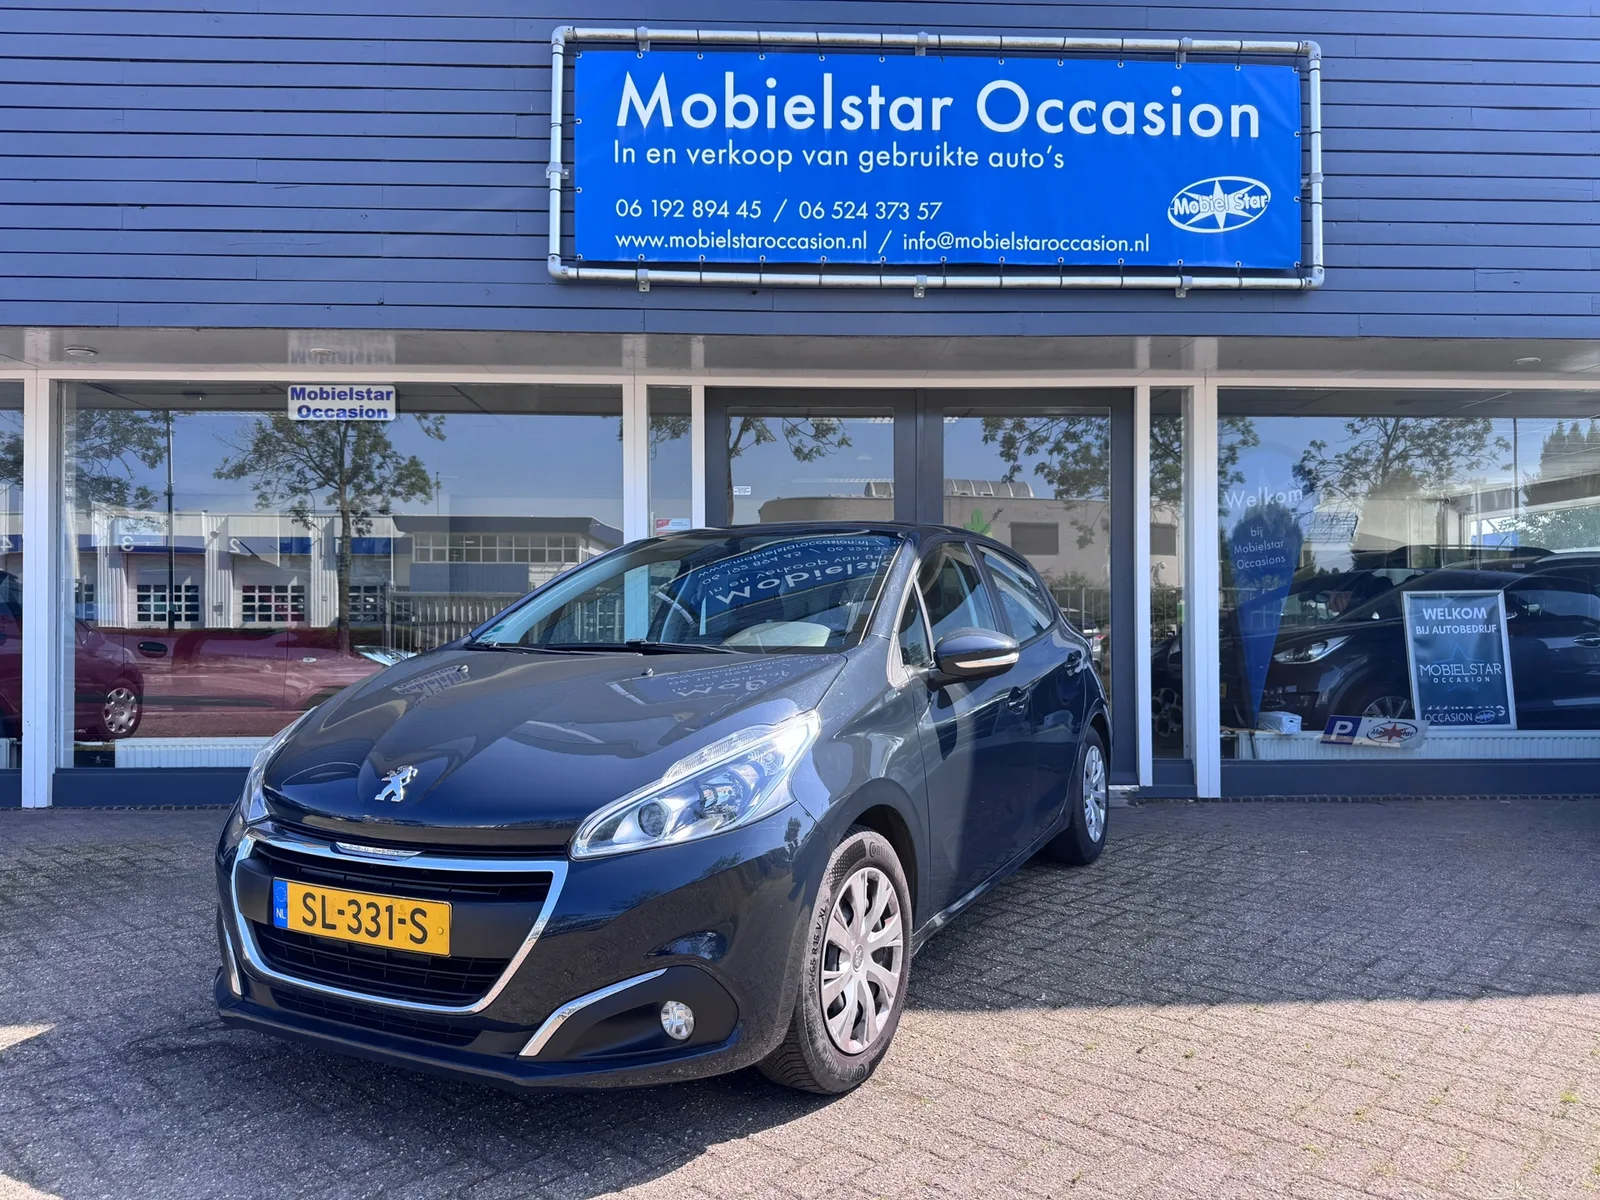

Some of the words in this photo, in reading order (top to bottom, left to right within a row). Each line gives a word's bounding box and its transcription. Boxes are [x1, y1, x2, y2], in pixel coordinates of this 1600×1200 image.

[616, 71, 954, 132] Mobielstar
[976, 79, 1259, 138] Occasion
[614, 139, 635, 163] In
[646, 148, 676, 164] en
[686, 139, 793, 172] verkoop
[802, 149, 848, 166] van
[858, 141, 979, 173] gebruikte
[988, 144, 1064, 169] auto's
[1173, 193, 1230, 215] Mobiel
[1234, 192, 1268, 211] Star
[615, 199, 642, 218] 06
[651, 199, 685, 218] 192
[692, 199, 730, 218] 894
[735, 200, 761, 219] 45
[773, 199, 788, 223] /
[799, 201, 825, 219] 06
[831, 201, 869, 219] 524
[875, 201, 910, 219] 373
[917, 202, 943, 220] 57
[615, 229, 867, 250] www.mobielstaroccasion.nl
[878, 229, 893, 254] /
[903, 230, 1149, 253] info@mobielstaroccasion.nl
[290, 387, 394, 401] Mobielstar
[297, 405, 388, 419] Occasion
[1223, 487, 1303, 509] Welkom
[1250, 526, 1264, 538] bij
[1234, 540, 1285, 554] Mobielstar
[1236, 555, 1286, 569] Occasions
[1422, 607, 1487, 620] WELKOM
[1415, 626, 1430, 635] BIJ
[1432, 624, 1497, 634] AUTOBEDRIJF
[1419, 663, 1502, 677] MOBIELSTAR
[1433, 676, 1490, 684] OCCASION
[1424, 713, 1473, 723] OCCASION
[1330, 720, 1354, 740] P
[275, 908, 287, 920] NL
[302, 892, 428, 944] SL-331-S
